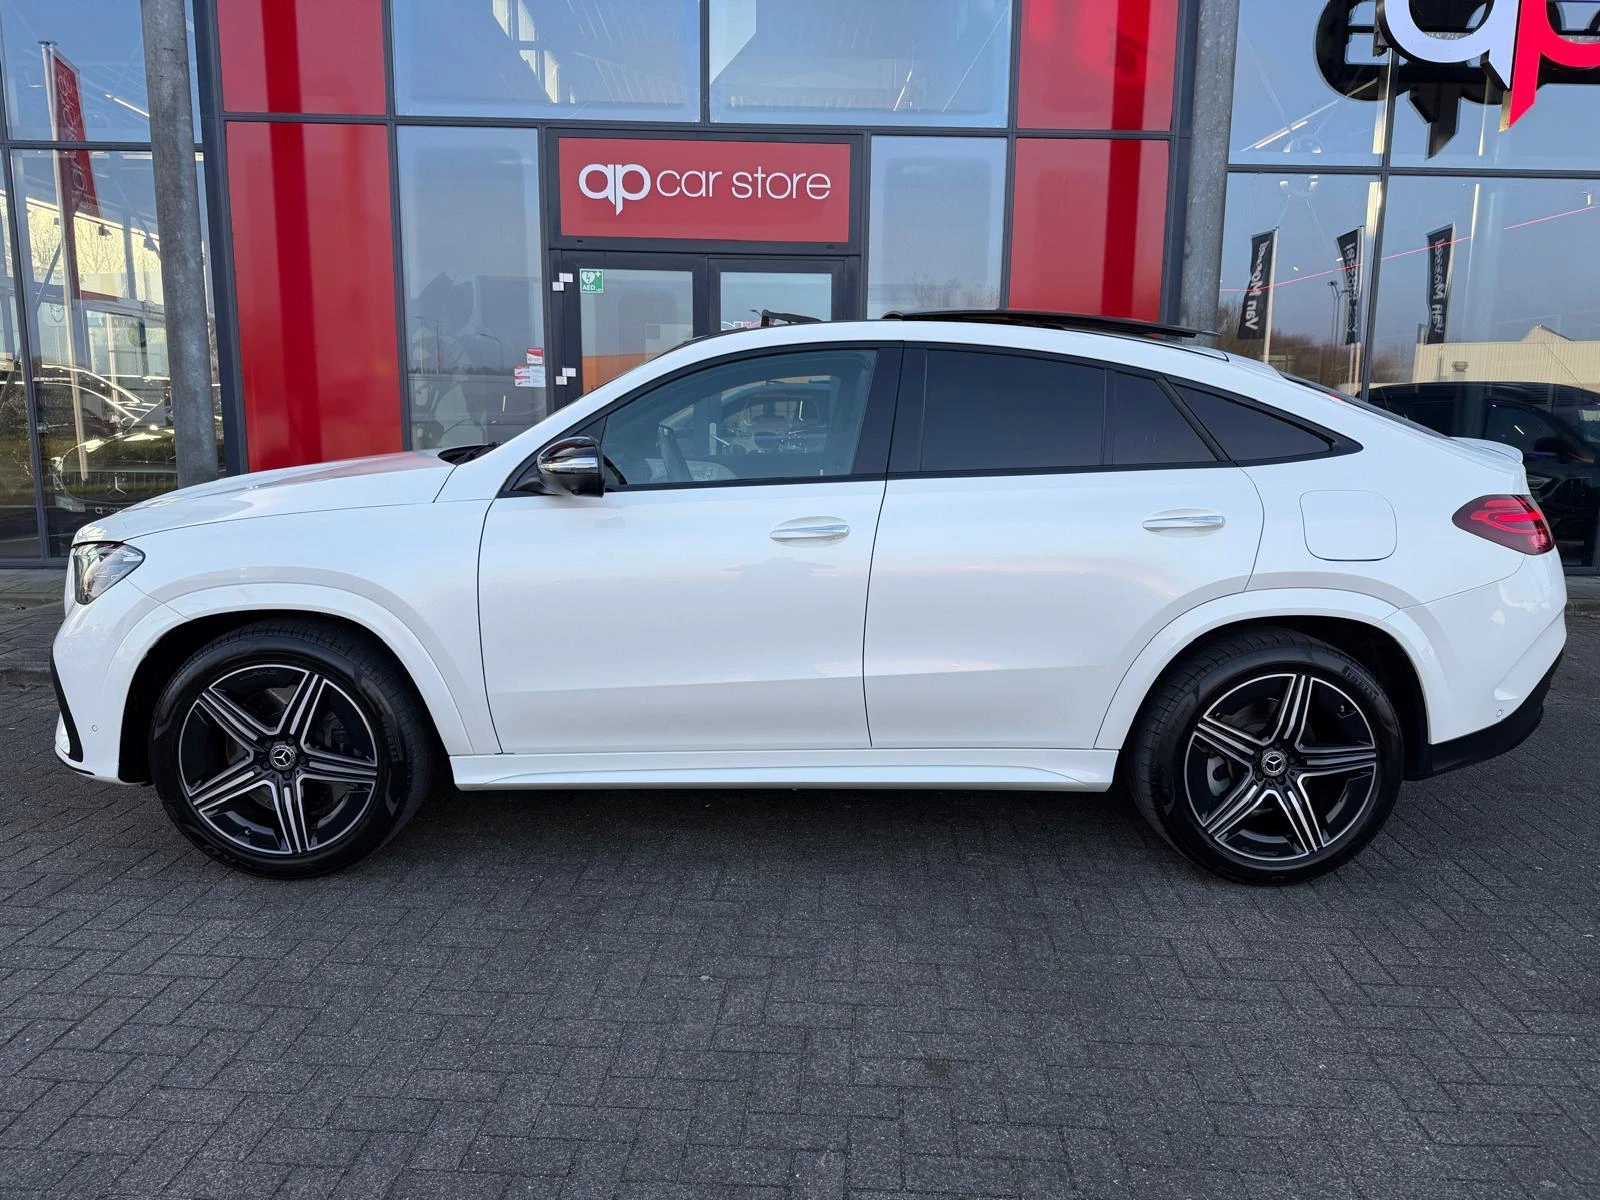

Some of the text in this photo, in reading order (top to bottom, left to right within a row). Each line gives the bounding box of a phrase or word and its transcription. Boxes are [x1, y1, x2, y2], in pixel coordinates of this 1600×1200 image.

[578, 164, 831, 216] ap car store
